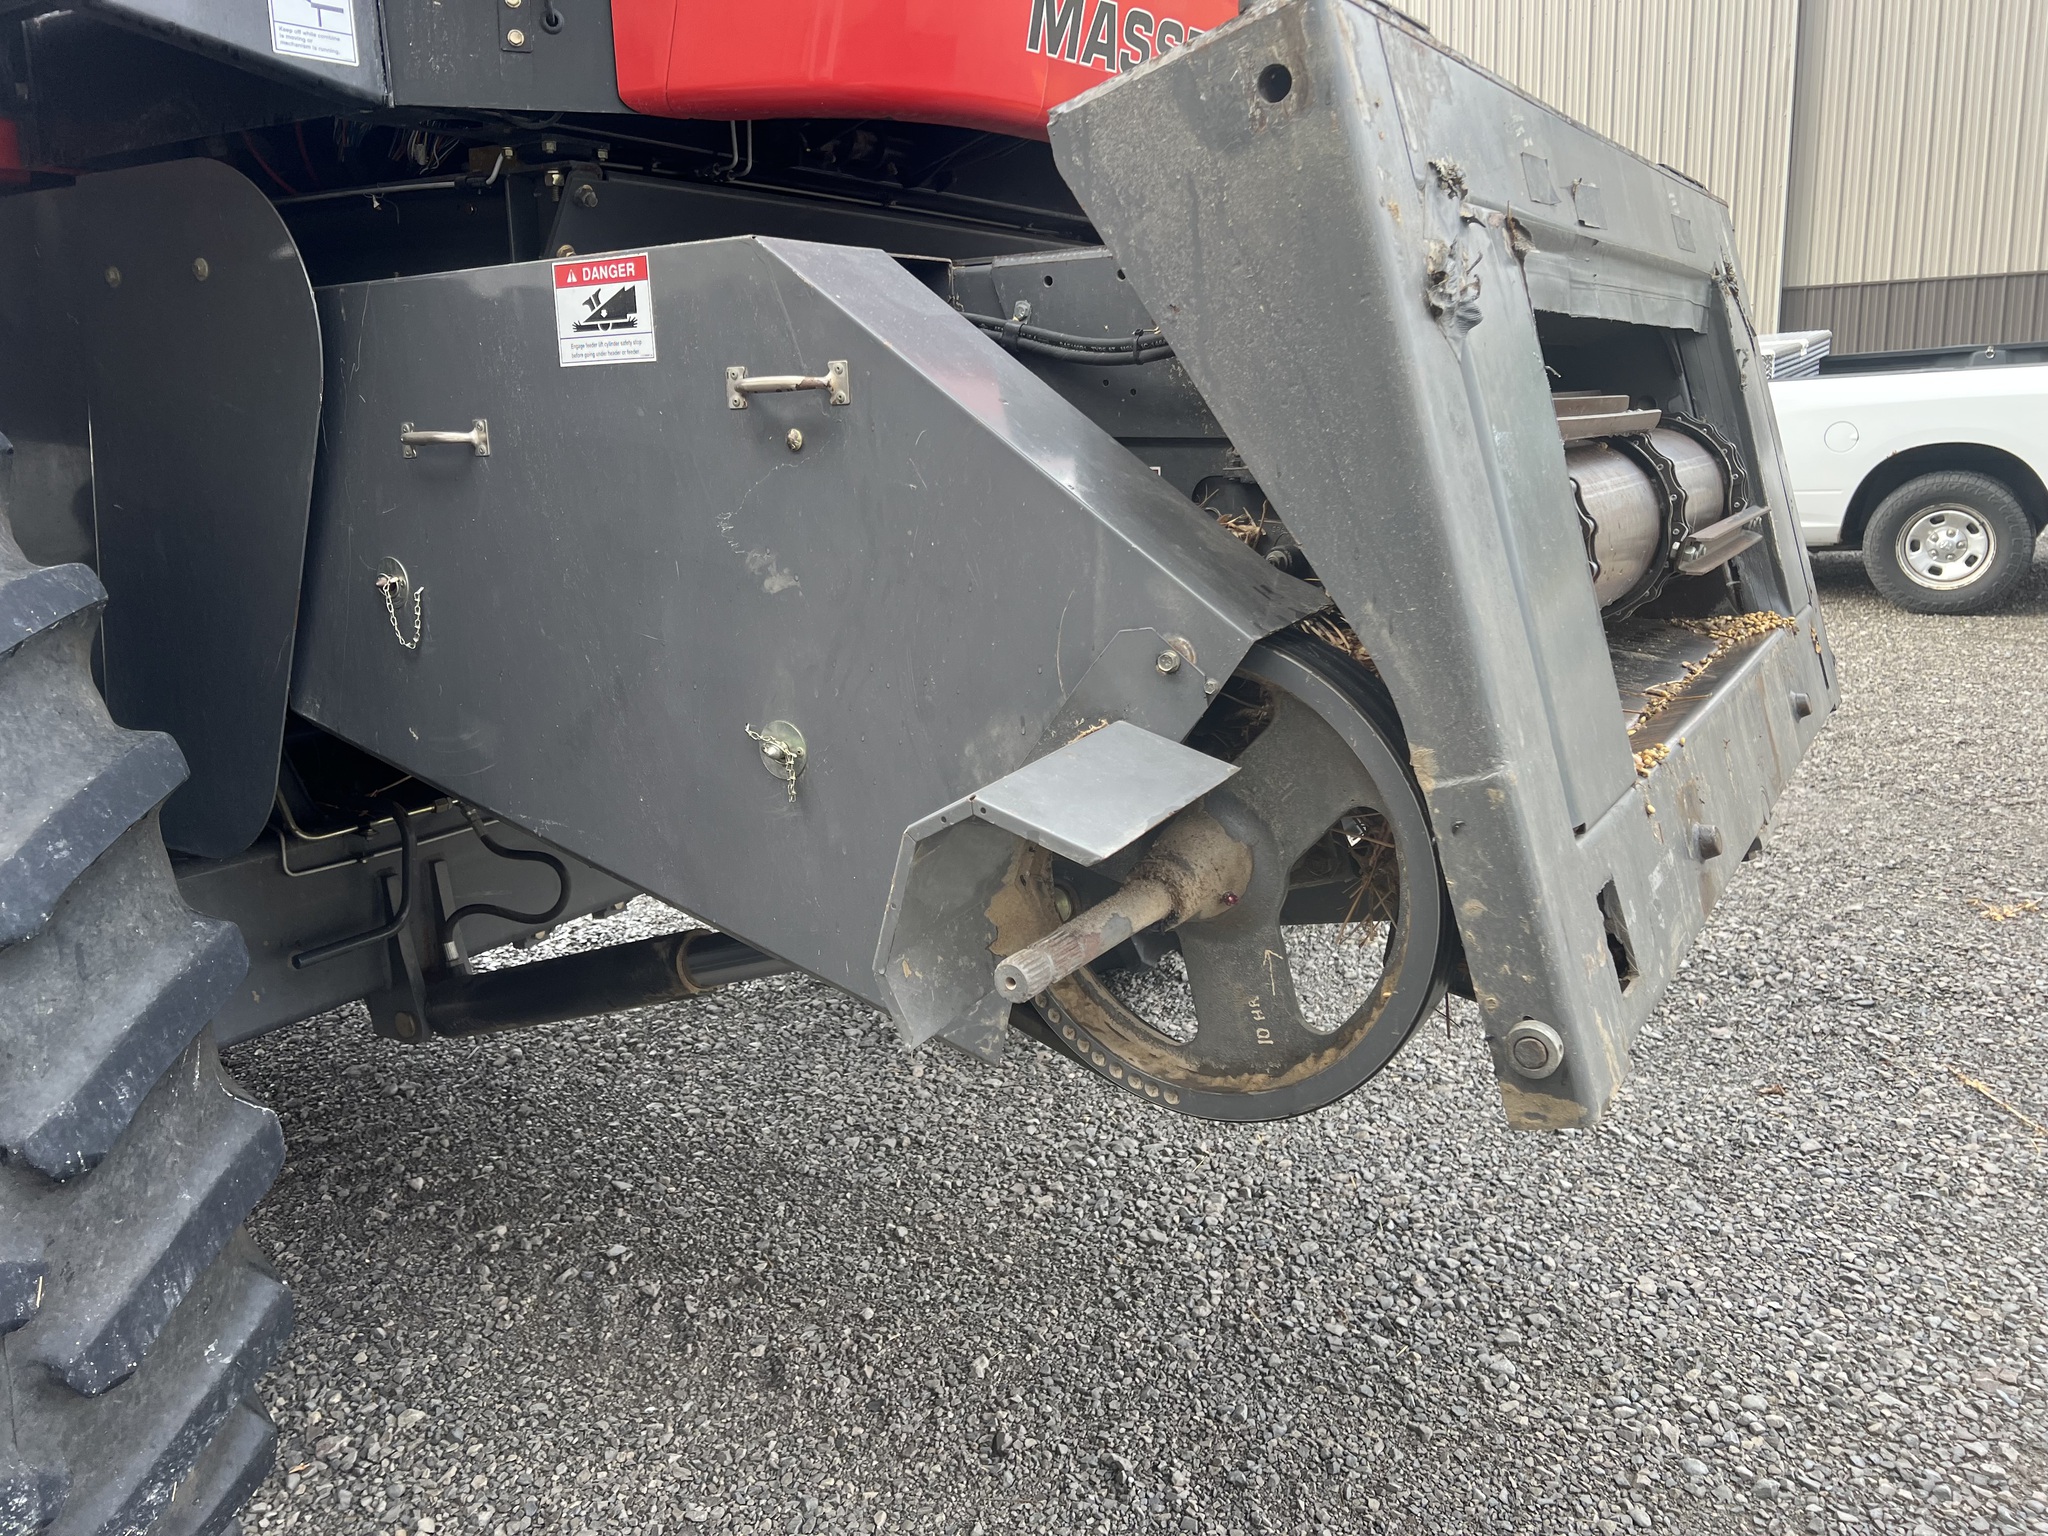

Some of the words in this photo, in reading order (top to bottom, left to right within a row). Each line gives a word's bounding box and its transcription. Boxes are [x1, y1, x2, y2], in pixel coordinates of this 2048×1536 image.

[278, 26, 293, 34] Keep
[317, 34, 341, 42] combine
[285, 35, 306, 44] moving
[1026, 0, 1206, 75] MASS
[279, 40, 312, 49] mechanism
[582, 263, 635, 281] DANGER
[604, 341, 619, 349] cylinder
[1248, 996, 1265, 1020] HR
[1257, 1028, 1274, 1044] 10
